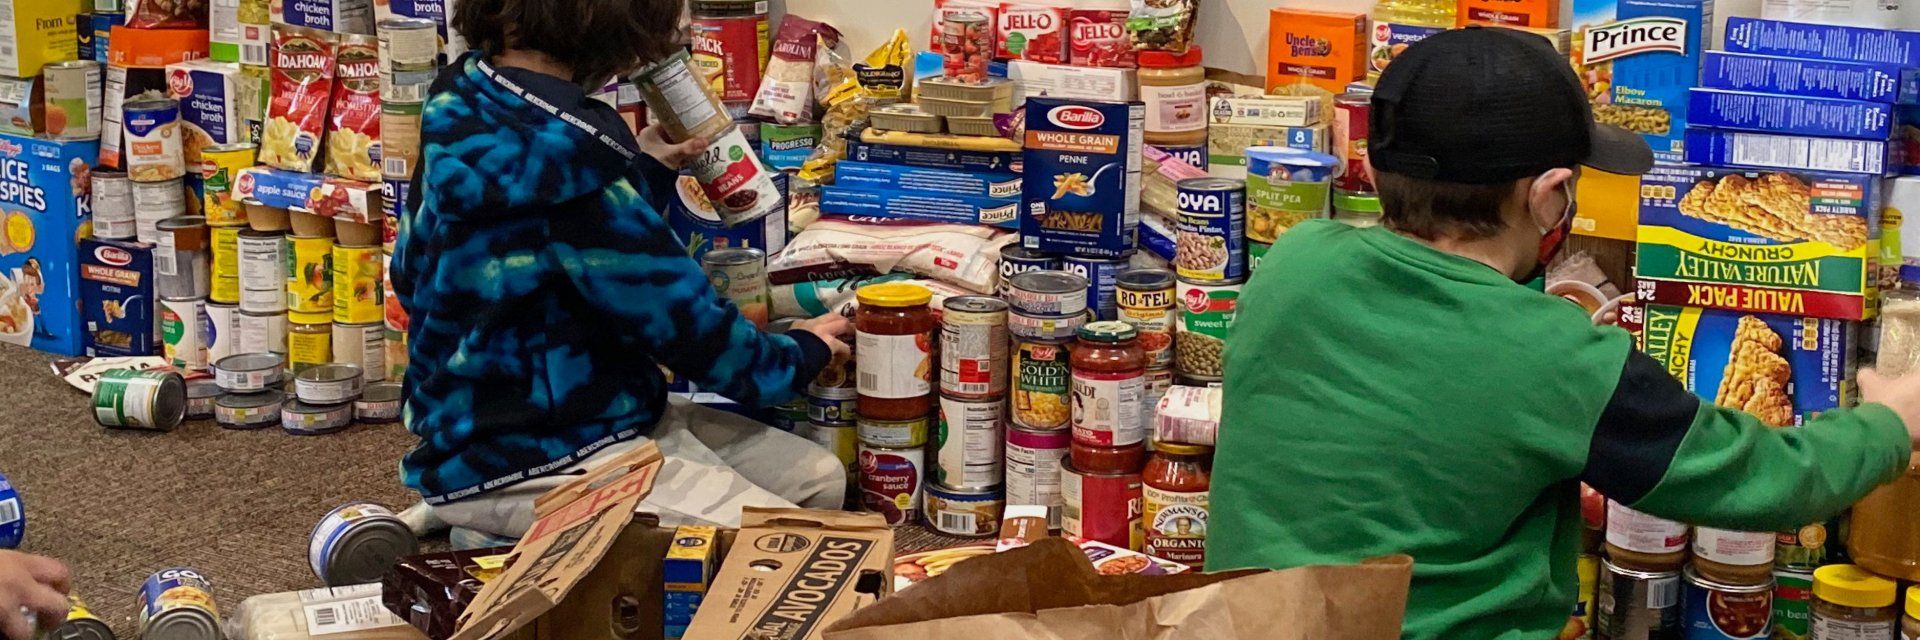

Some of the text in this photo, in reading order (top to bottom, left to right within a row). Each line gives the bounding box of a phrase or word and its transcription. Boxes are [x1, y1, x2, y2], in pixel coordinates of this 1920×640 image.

[294, 2, 330, 15] chicken
[414, 1, 442, 13] broth
[36, 17, 62, 31] From
[304, 13, 330, 26] broth
[1286, 32, 1315, 46] Uncle
[1591, 23, 1677, 53] Prince
[772, 39, 812, 59] CAROLINA
[278, 52, 326, 69] IDAHOAN
[338, 62, 380, 77] DAHOA
[1615, 85, 1645, 97] Elbow
[191, 100, 223, 113] chicken
[1614, 95, 1662, 107] Macaroni
[201, 110, 224, 123] broth
[559, 112, 598, 136] ABERCROMBIE
[1060, 109, 1100, 125] Barilla
[251, 124, 262, 142] 365
[1037, 133, 1114, 147] WHOLE GRAIN
[1294, 130, 1305, 143] 8
[771, 138, 813, 151] PROGRESSO
[1058, 155, 1088, 165] PENNE
[0, 158, 28, 185] ICE
[718, 174, 744, 194] BEANS
[257, 184, 281, 196] apple
[282, 188, 307, 200] sauce
[1256, 189, 1301, 204] SPLIT PEA
[1178, 192, 1222, 213] OYA
[1815, 205, 1857, 215] VARIETY PACK
[982, 208, 1014, 220] Prince
[1698, 243, 1794, 260] CRUNCHY
[87, 265, 137, 281] WHOLE GRAIN
[1675, 251, 1820, 287] NATURE VALLEY
[1637, 289, 1656, 301] 24
[1688, 284, 1805, 313] VALUE PACK
[1621, 305, 1634, 323] 24
[1194, 319, 1223, 328] sweet
[1669, 331, 1690, 382] NCHY
[483, 470, 525, 490] ABERCROMBIE
[528, 454, 574, 476] ABERCROMBIE
[576, 435, 616, 458] ABERCROMBIE
[868, 474, 910, 483] cranberry
[883, 481, 909, 490] sauce
[1161, 493, 1188, 503] Profits
[1127, 497, 1143, 518] RE
[1155, 505, 1197, 530] NEWMAN'S
[772, 540, 862, 622] AVOCADOS
[1787, 608, 1808, 619] bea
